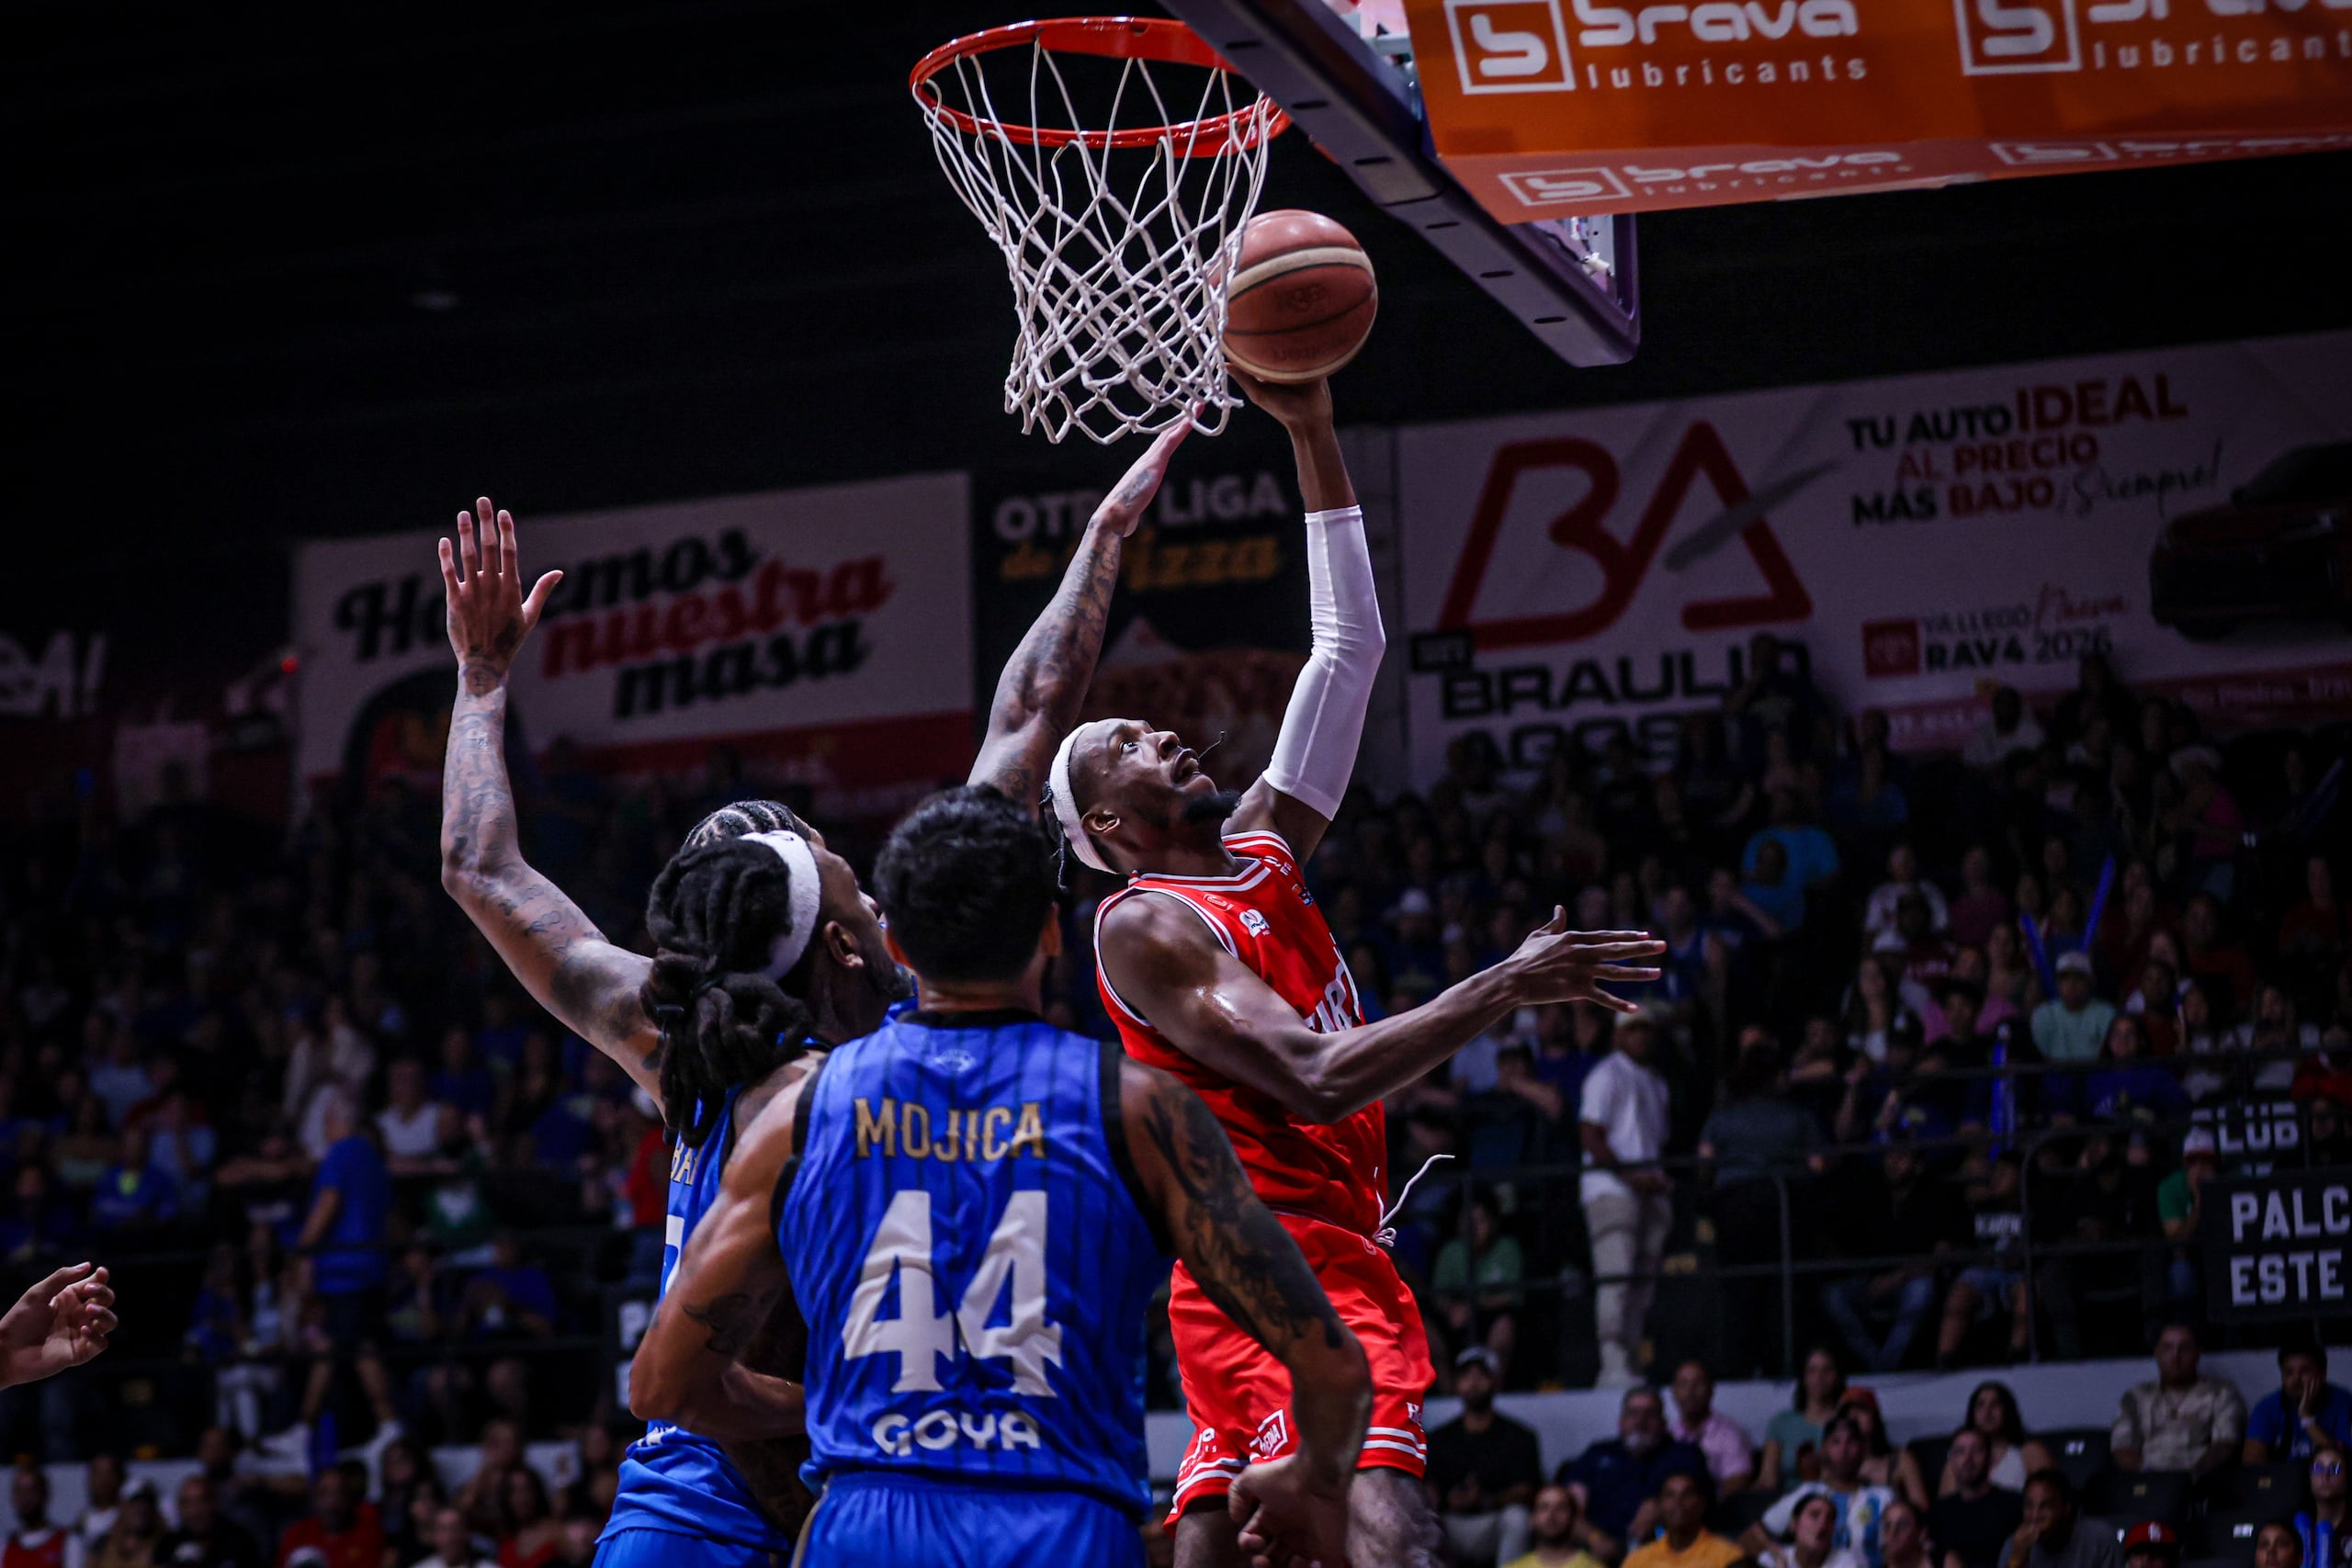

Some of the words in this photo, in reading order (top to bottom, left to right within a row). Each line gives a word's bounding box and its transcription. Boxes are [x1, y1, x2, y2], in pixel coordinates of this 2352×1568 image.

[1573, 0, 1859, 46] brava
[1587, 55, 1867, 89] lubricants
[1623, 152, 1902, 182] brava
[1848, 415, 1895, 449] TU
[1907, 404, 2012, 443] AUTO
[2017, 374, 2188, 433] IDEAL
[1895, 449, 1941, 483] AL
[1954, 434, 2098, 476] PRECIO
[993, 487, 1144, 542] OTR
[1158, 471, 1285, 528] LIGA
[1949, 478, 2055, 518] BAJO
[334, 527, 759, 660] Hemos
[541, 555, 895, 680] nuestra
[613, 617, 869, 719] masa
[854, 1097, 1048, 1163] MOJICA
[842, 1190, 1064, 1399] 44
[2229, 1248, 2345, 1308] ESTE
[872, 1409, 1042, 1458] GOYA
